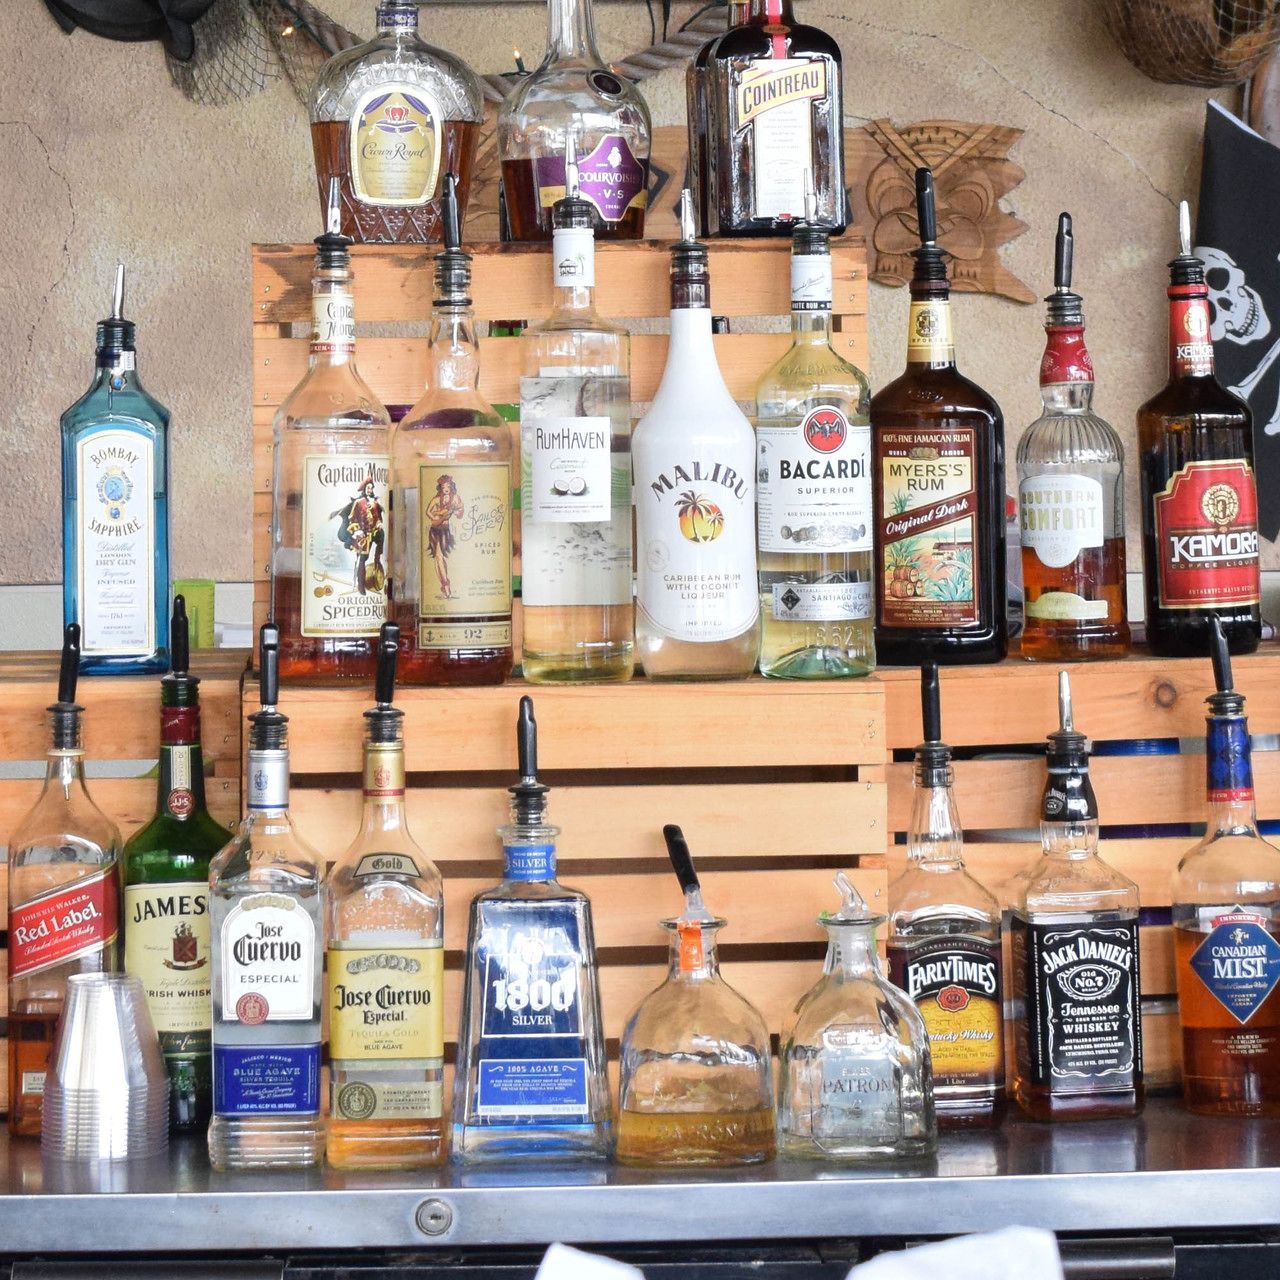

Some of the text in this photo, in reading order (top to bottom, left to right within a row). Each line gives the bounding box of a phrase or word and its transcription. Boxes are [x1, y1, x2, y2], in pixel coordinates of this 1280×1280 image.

[742, 69, 820, 116] COINTREAU
[361, 141, 428, 161] Crown Royal
[536, 427, 605, 451] RUMHAVEN
[898, 433, 971, 444] FINE JAMAICAN RUM
[89, 446, 140, 470] BOMBAY
[779, 452, 866, 480] BACARDÍ
[888, 463, 965, 477] MYERS'S
[317, 463, 365, 488] Captain
[650, 460, 749, 502] MALIBU
[797, 486, 855, 495] SUPERIOR
[907, 478, 945, 491] RUM
[1021, 489, 1095, 505] SOUTHERN
[885, 497, 969, 536] Original Dark
[1020, 506, 1097, 531] COMFORT
[87, 517, 143, 538] SAPPHIRE
[1170, 530, 1259, 563] KAMORA
[95, 558, 137, 567] DRY GIN
[1171, 561, 1218, 570] COFFEE
[663, 573, 721, 582] CARIBBEAN
[666, 583, 691, 591] WITH
[337, 596, 384, 606] ORIGINAL
[681, 592, 725, 600] LIQUEUR
[322, 605, 373, 621] SPICED
[371, 857, 404, 870] Gold
[512, 858, 548, 868] SILVER
[1219, 914, 1257, 922] IMPORTED
[14, 920, 51, 947] Red
[255, 921, 284, 941] Jose
[232, 933, 302, 967] Cuervo
[1041, 936, 1133, 974] JACK DANIEL'S
[1211, 944, 1267, 958] CANADIAN
[239, 974, 299, 984] ESPECIAL
[907, 955, 997, 998] EARLY TIMES
[1074, 976, 1104, 989] No.7
[333, 983, 432, 1011] Jose Cuervo
[492, 978, 575, 1012] 1800
[1060, 1002, 1120, 1017] Tennessee
[512, 1015, 553, 1026] SILVER
[1062, 1021, 1120, 1034] WHISKEY
[350, 1027, 420, 1038] TEQUILA GOLD
[960, 1029, 995, 1041] Whisky
[363, 1043, 381, 1051] BLUE
[233, 1067, 301, 1076] BLUE AGAVE
[507, 1065, 526, 1073] 100%
